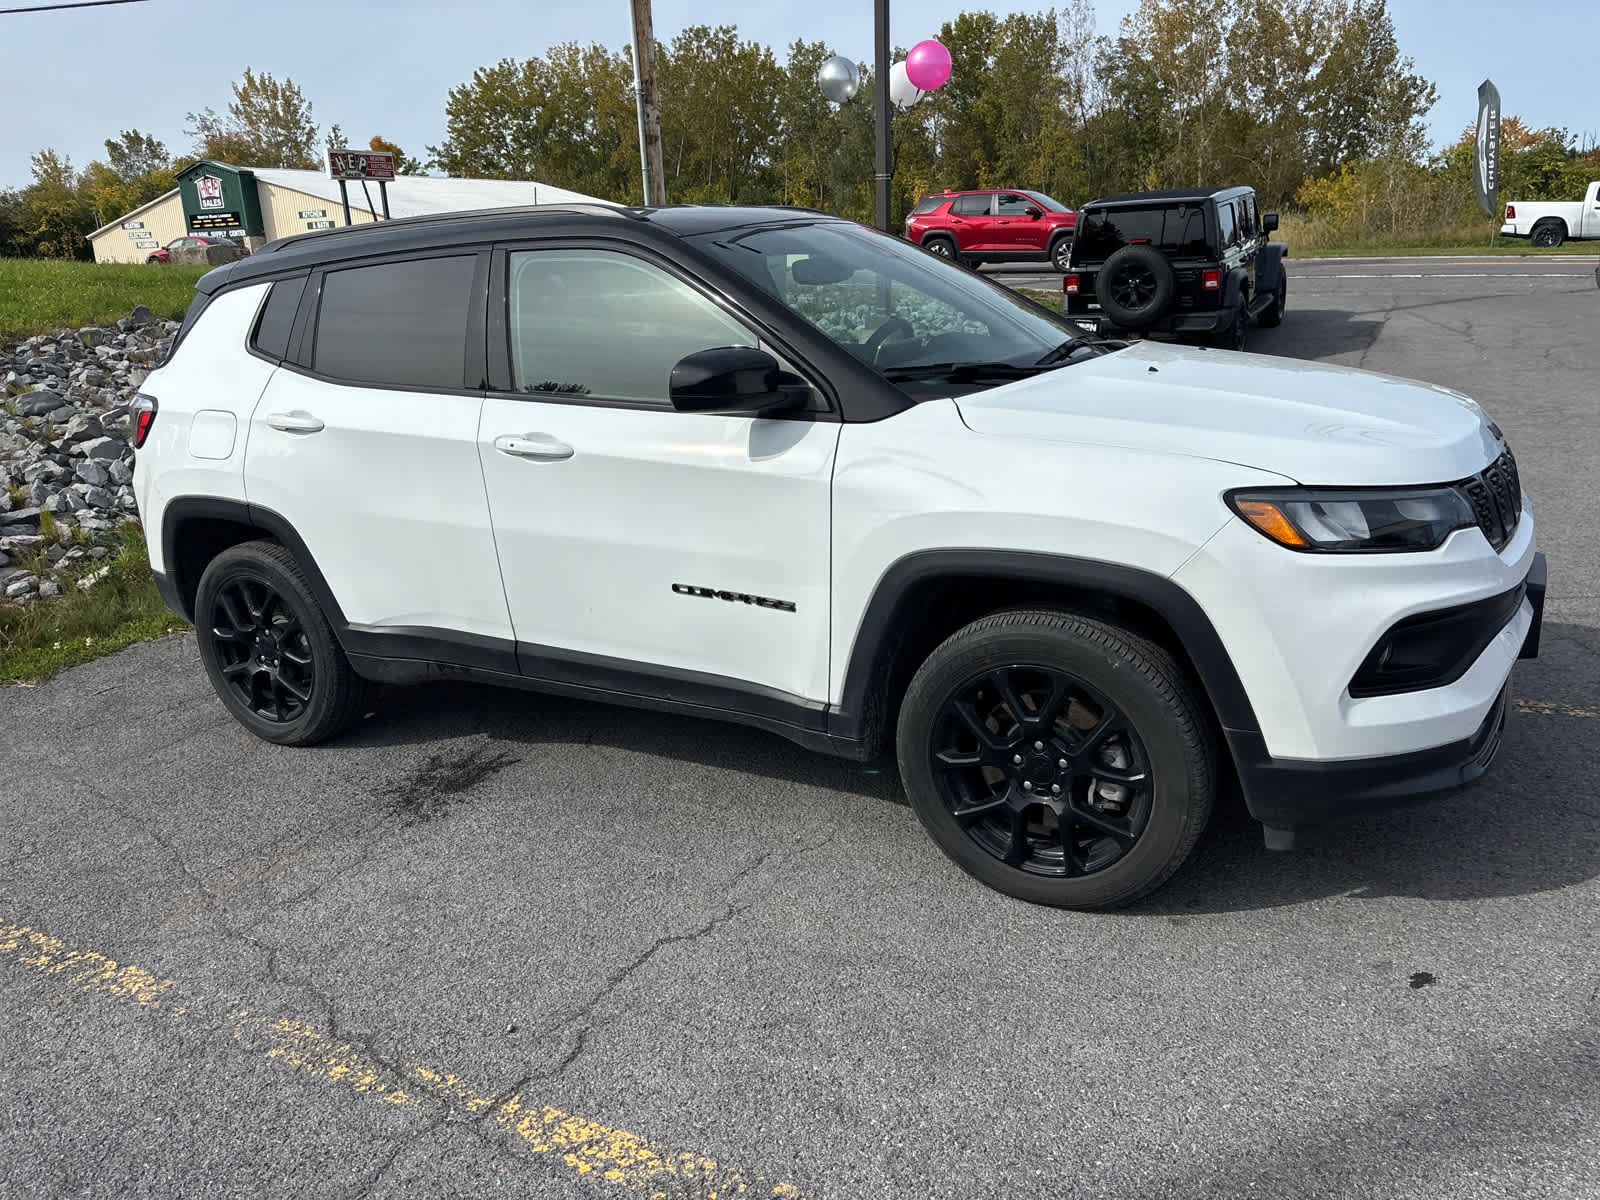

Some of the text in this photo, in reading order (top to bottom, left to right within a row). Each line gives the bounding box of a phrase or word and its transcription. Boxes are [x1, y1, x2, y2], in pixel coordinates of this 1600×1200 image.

[335, 154, 367, 171] HEP
[199, 179, 219, 196] HEP
[202, 198, 221, 207] SALES
